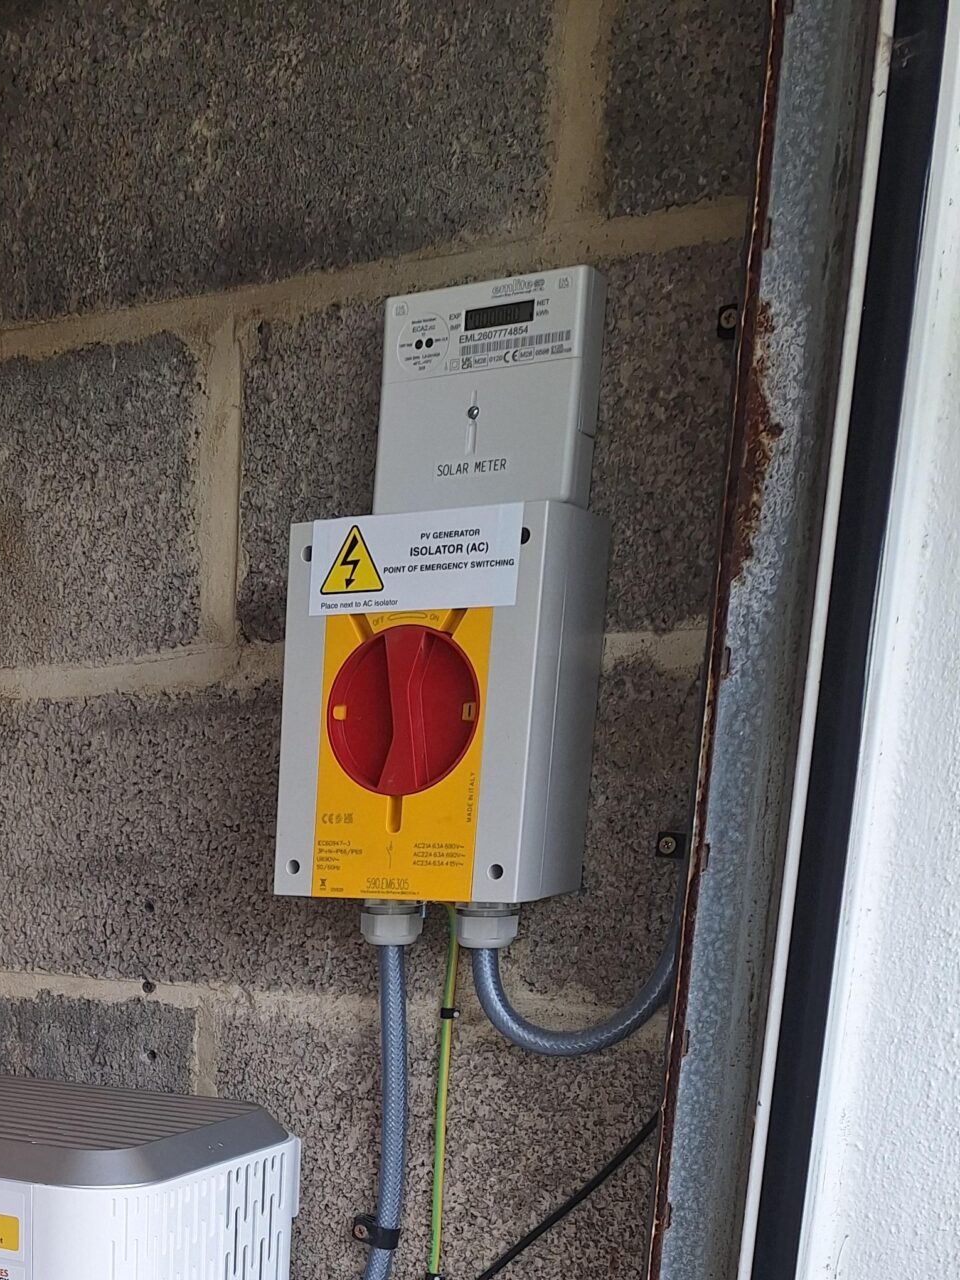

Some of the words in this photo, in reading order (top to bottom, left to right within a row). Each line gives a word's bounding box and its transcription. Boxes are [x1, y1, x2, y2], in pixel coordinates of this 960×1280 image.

[459, 325, 529, 344] EML2607774854
[437, 463, 469, 477] SOLAR
[474, 458, 507, 473] METER
[420, 532, 431, 540] PV
[432, 529, 481, 539] GENERATOR
[410, 543, 463, 557] ISOLATOR
[466, 542, 489, 555] (AC)
[383, 565, 406, 574] POINT
[408, 564, 418, 572] OF
[420, 561, 468, 572] EMERGENCY
[470, 559, 515, 569] SWITCHING
[374, 599, 398, 607] isolator
[372, 616, 385, 626] OFF
[429, 614, 440, 622] ON
